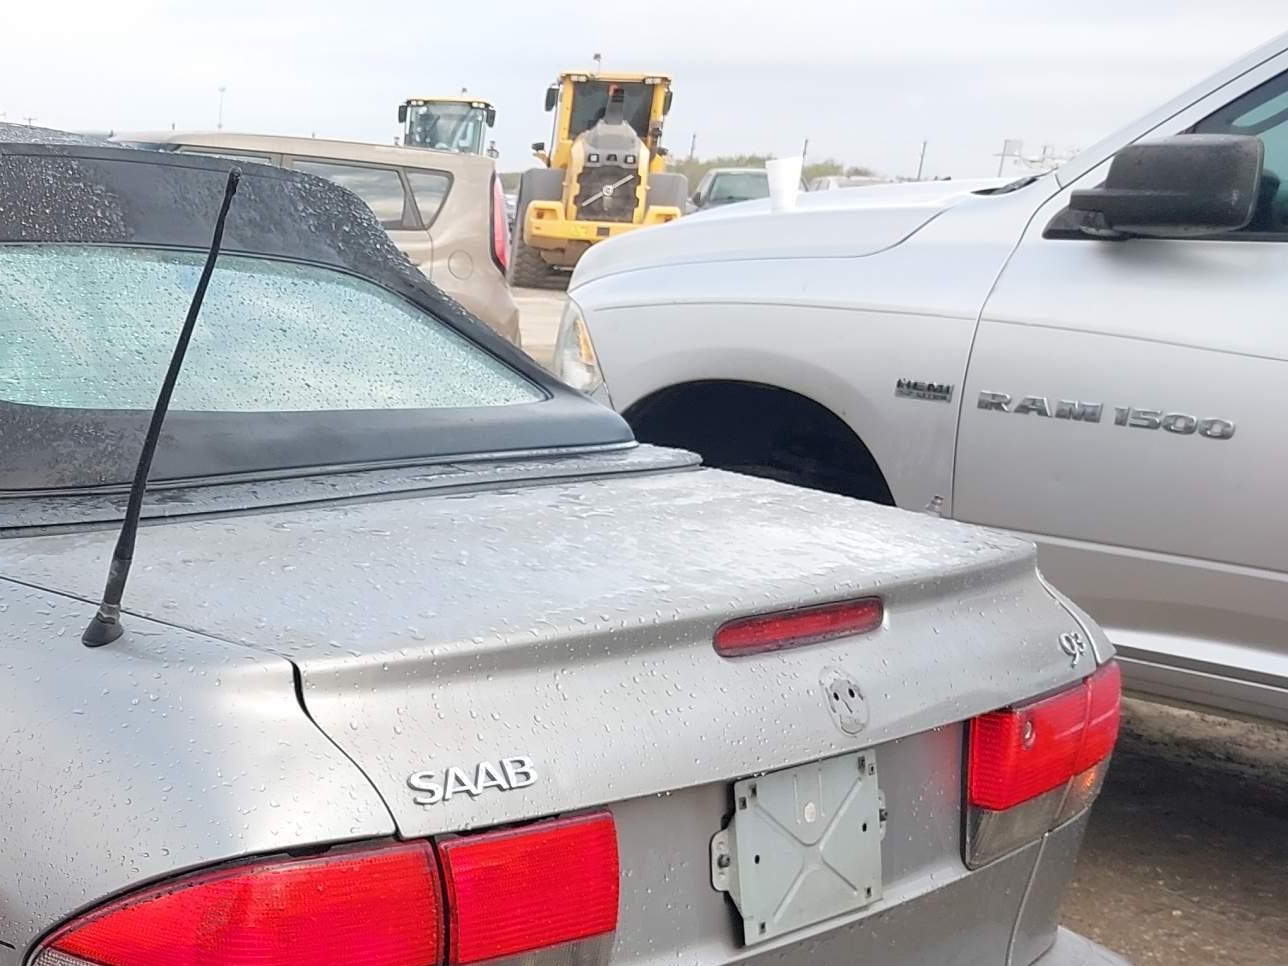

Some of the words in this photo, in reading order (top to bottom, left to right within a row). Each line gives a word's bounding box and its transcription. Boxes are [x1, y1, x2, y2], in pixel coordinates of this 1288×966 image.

[895, 378, 954, 395] HEMI
[977, 391, 1104, 424] RAM
[1114, 406, 1237, 441] 1500
[406, 755, 539, 807] SAAB
